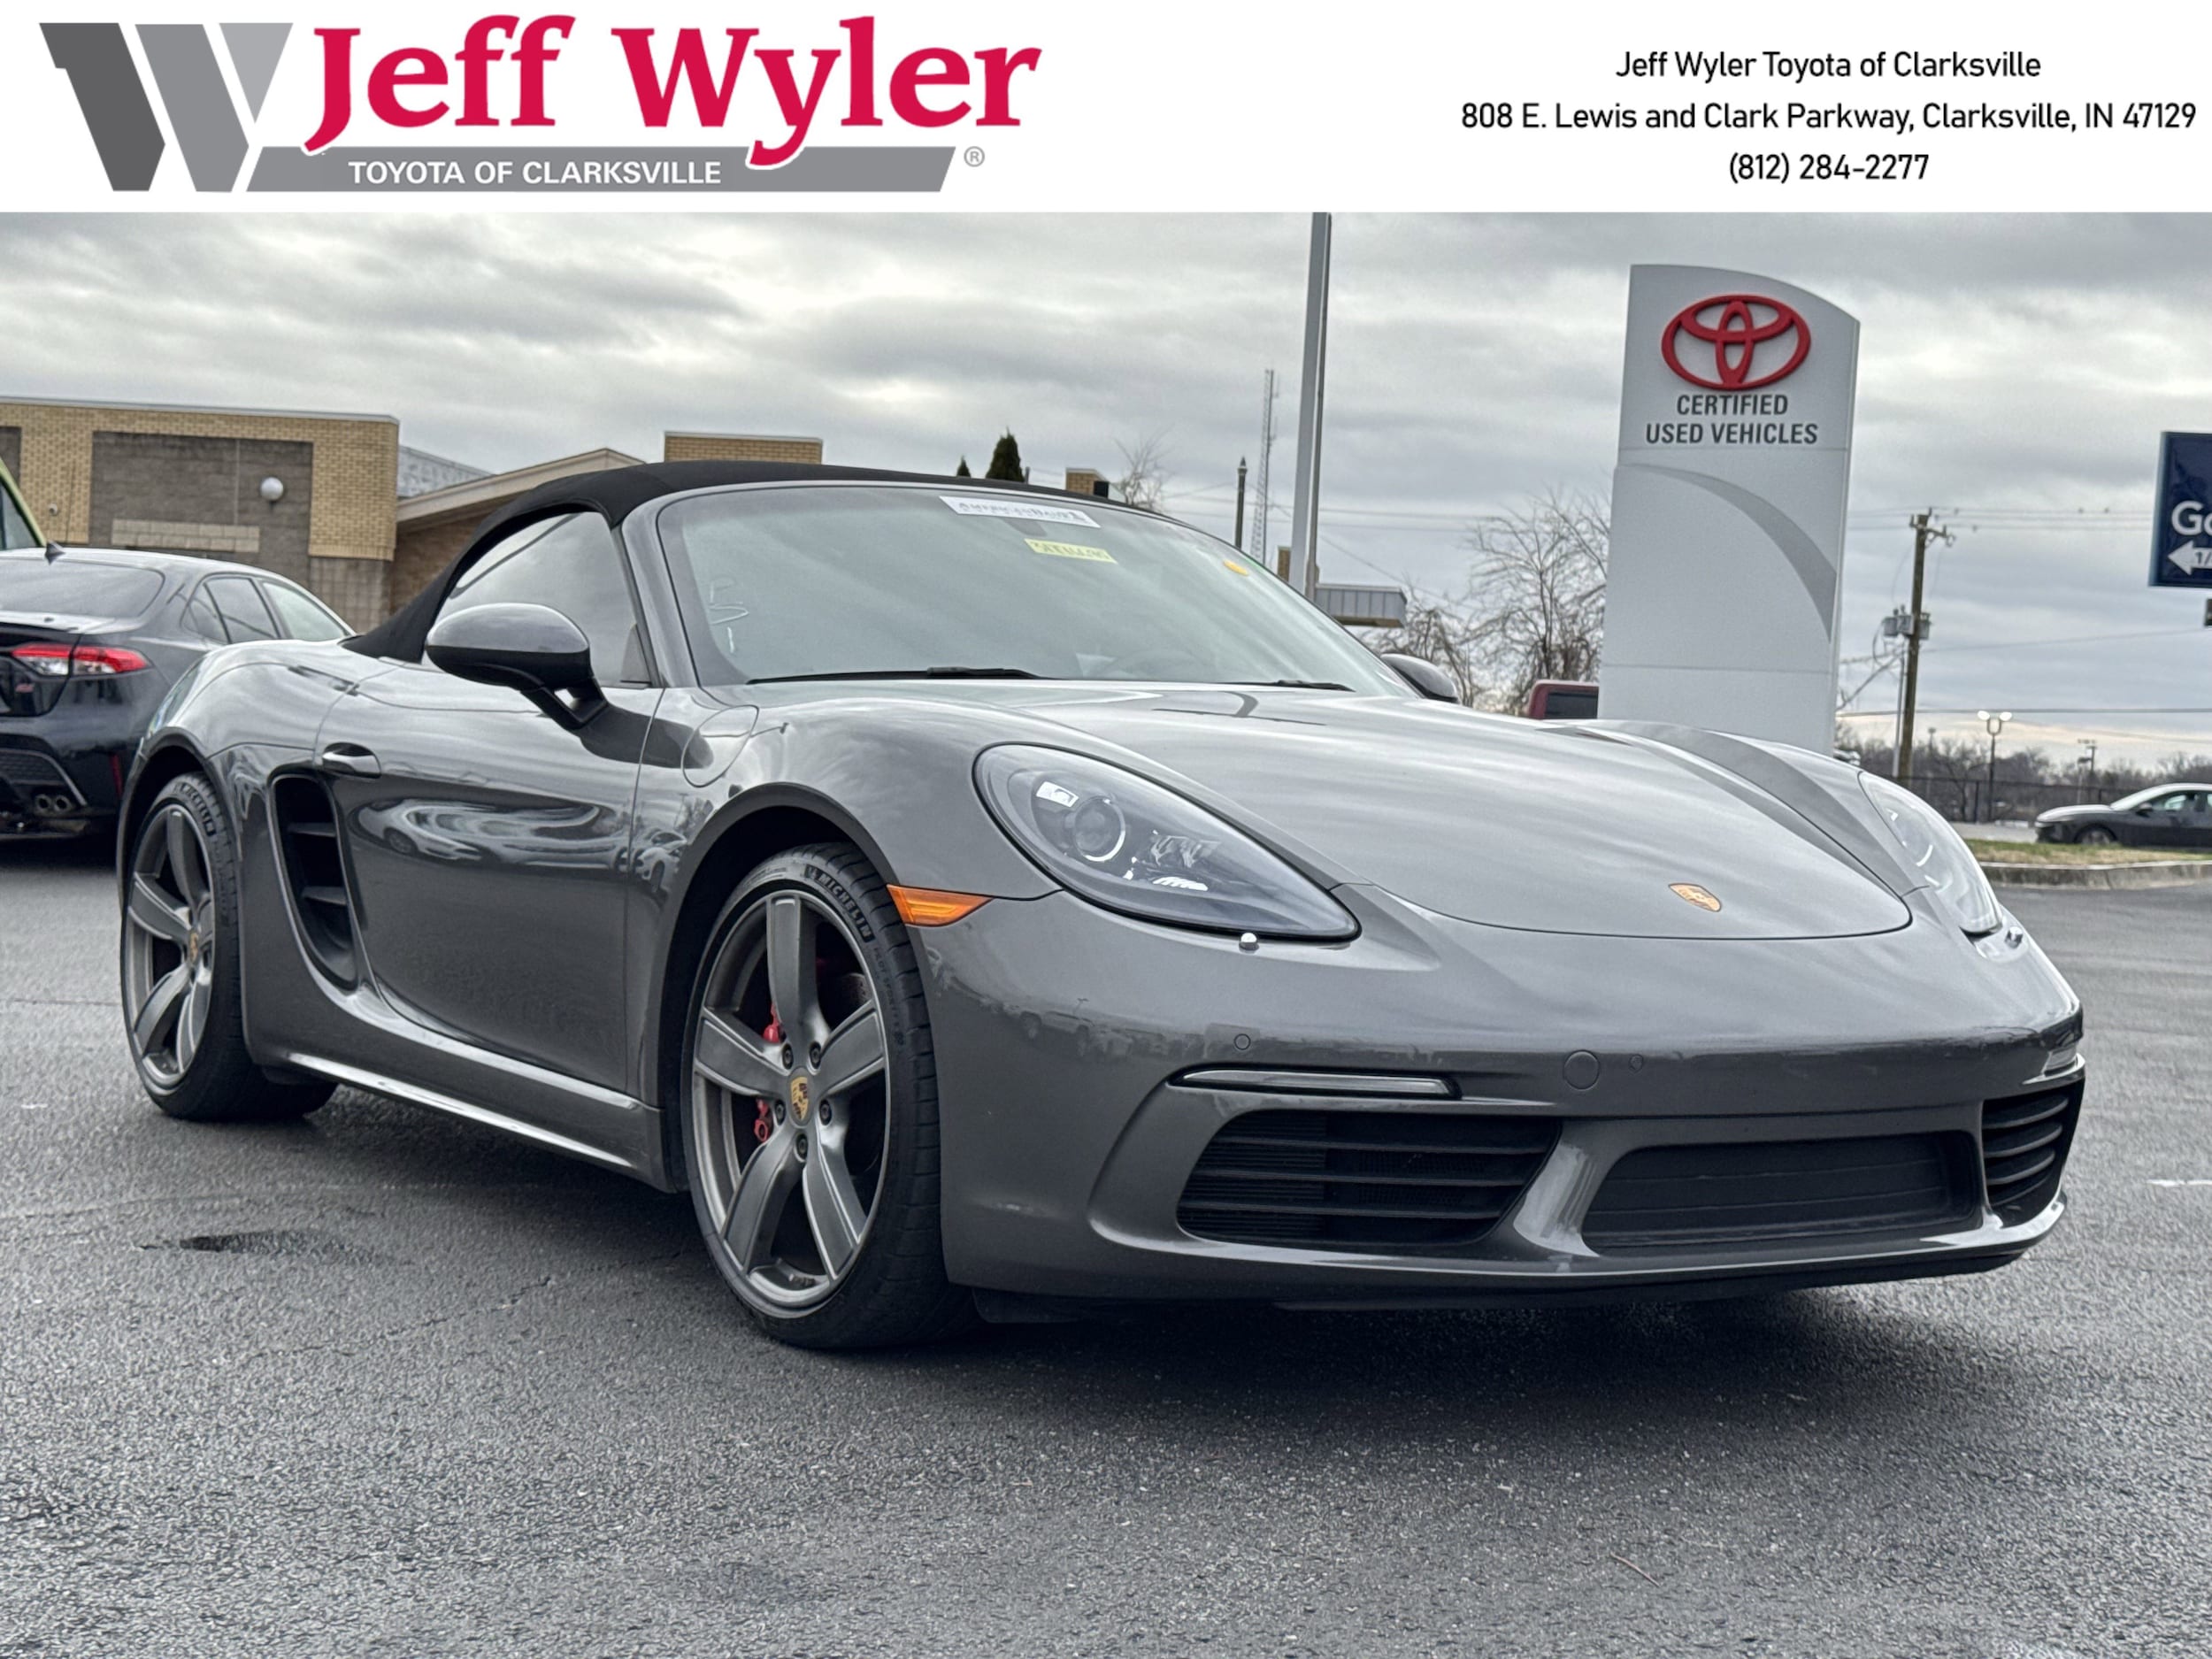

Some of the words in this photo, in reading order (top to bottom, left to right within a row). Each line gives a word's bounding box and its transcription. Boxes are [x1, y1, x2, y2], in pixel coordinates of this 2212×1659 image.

[1677, 394, 1788, 416] CERTIFIED
[1647, 423, 1703, 444] USED
[1712, 423, 1818, 444] VEHICLES
[816, 870, 873, 941] MICHELIN
